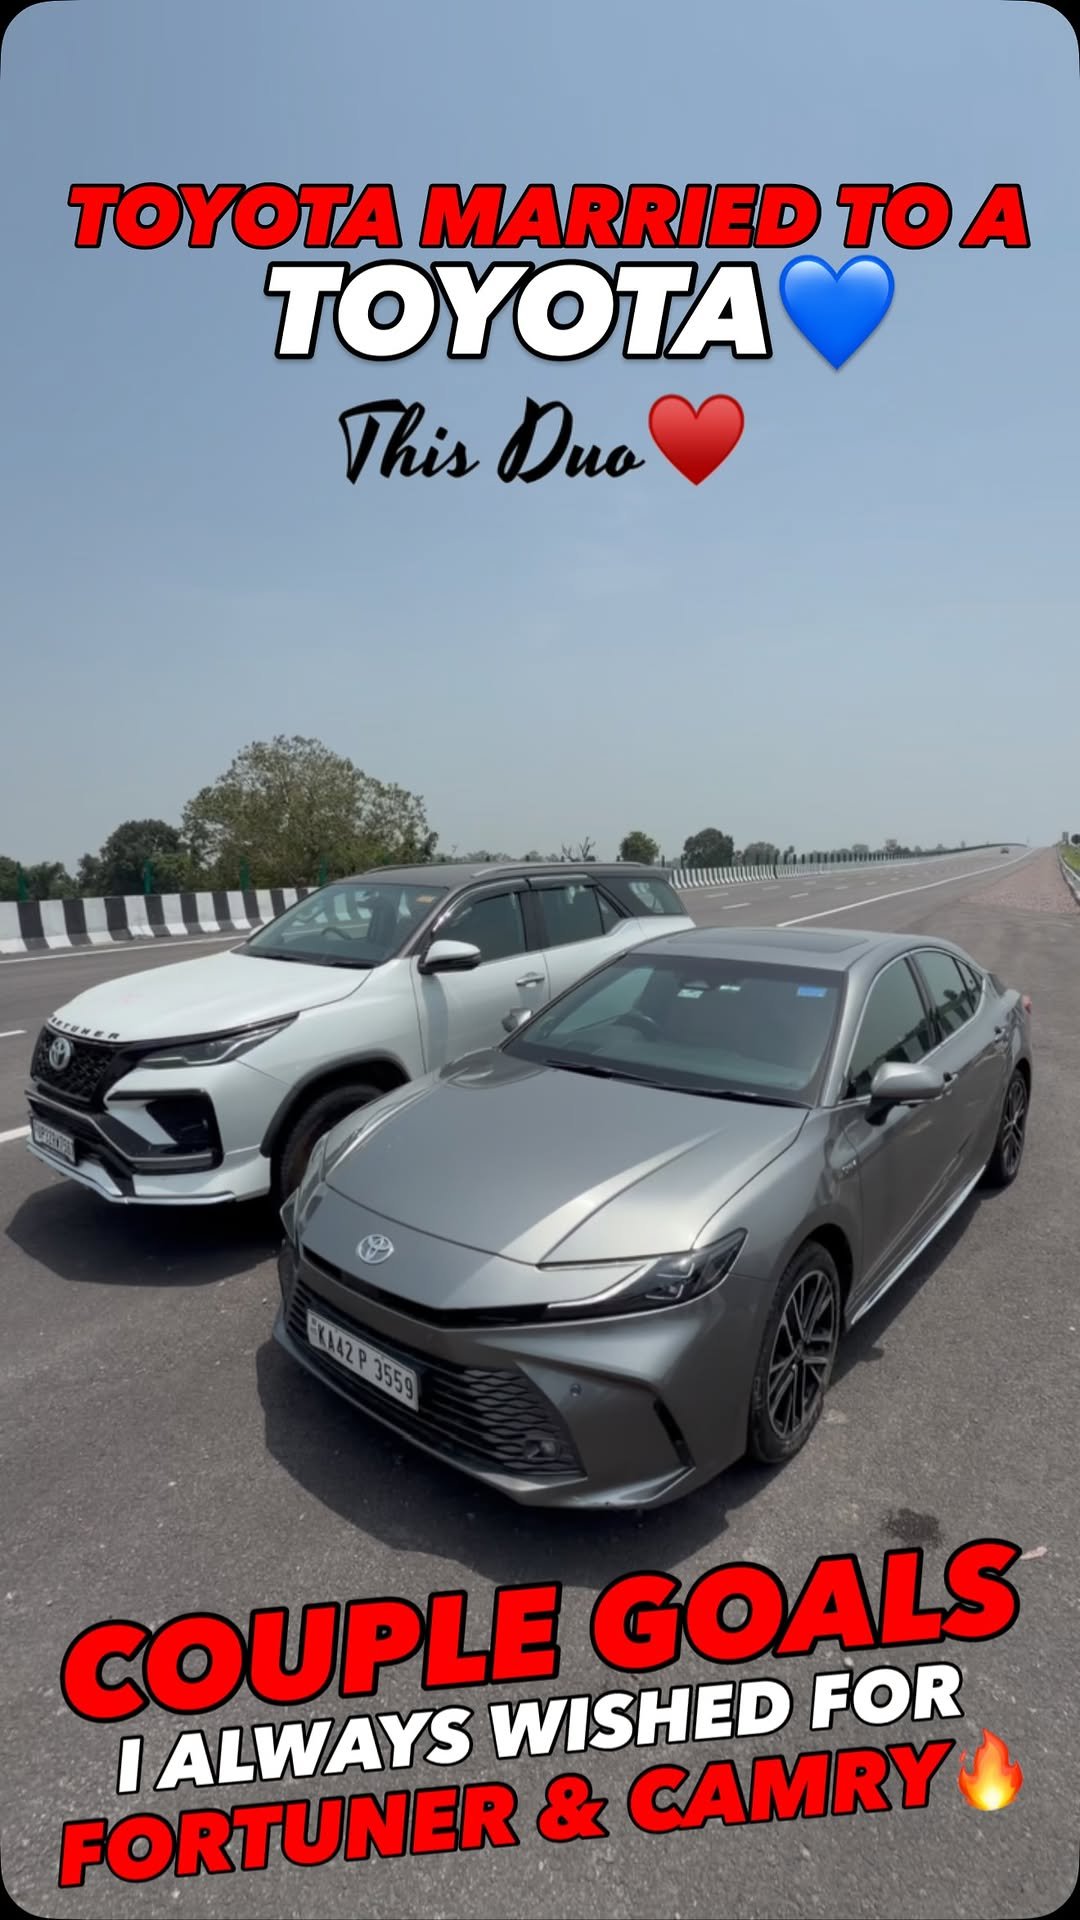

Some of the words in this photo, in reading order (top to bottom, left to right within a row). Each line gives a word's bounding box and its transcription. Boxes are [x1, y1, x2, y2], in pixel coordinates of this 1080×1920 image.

[50, 1017, 120, 1040] ORTUNER
[317, 1322, 354, 1365] KA42
[358, 1347, 367, 1370] P
[373, 1357, 414, 1401] 3559
